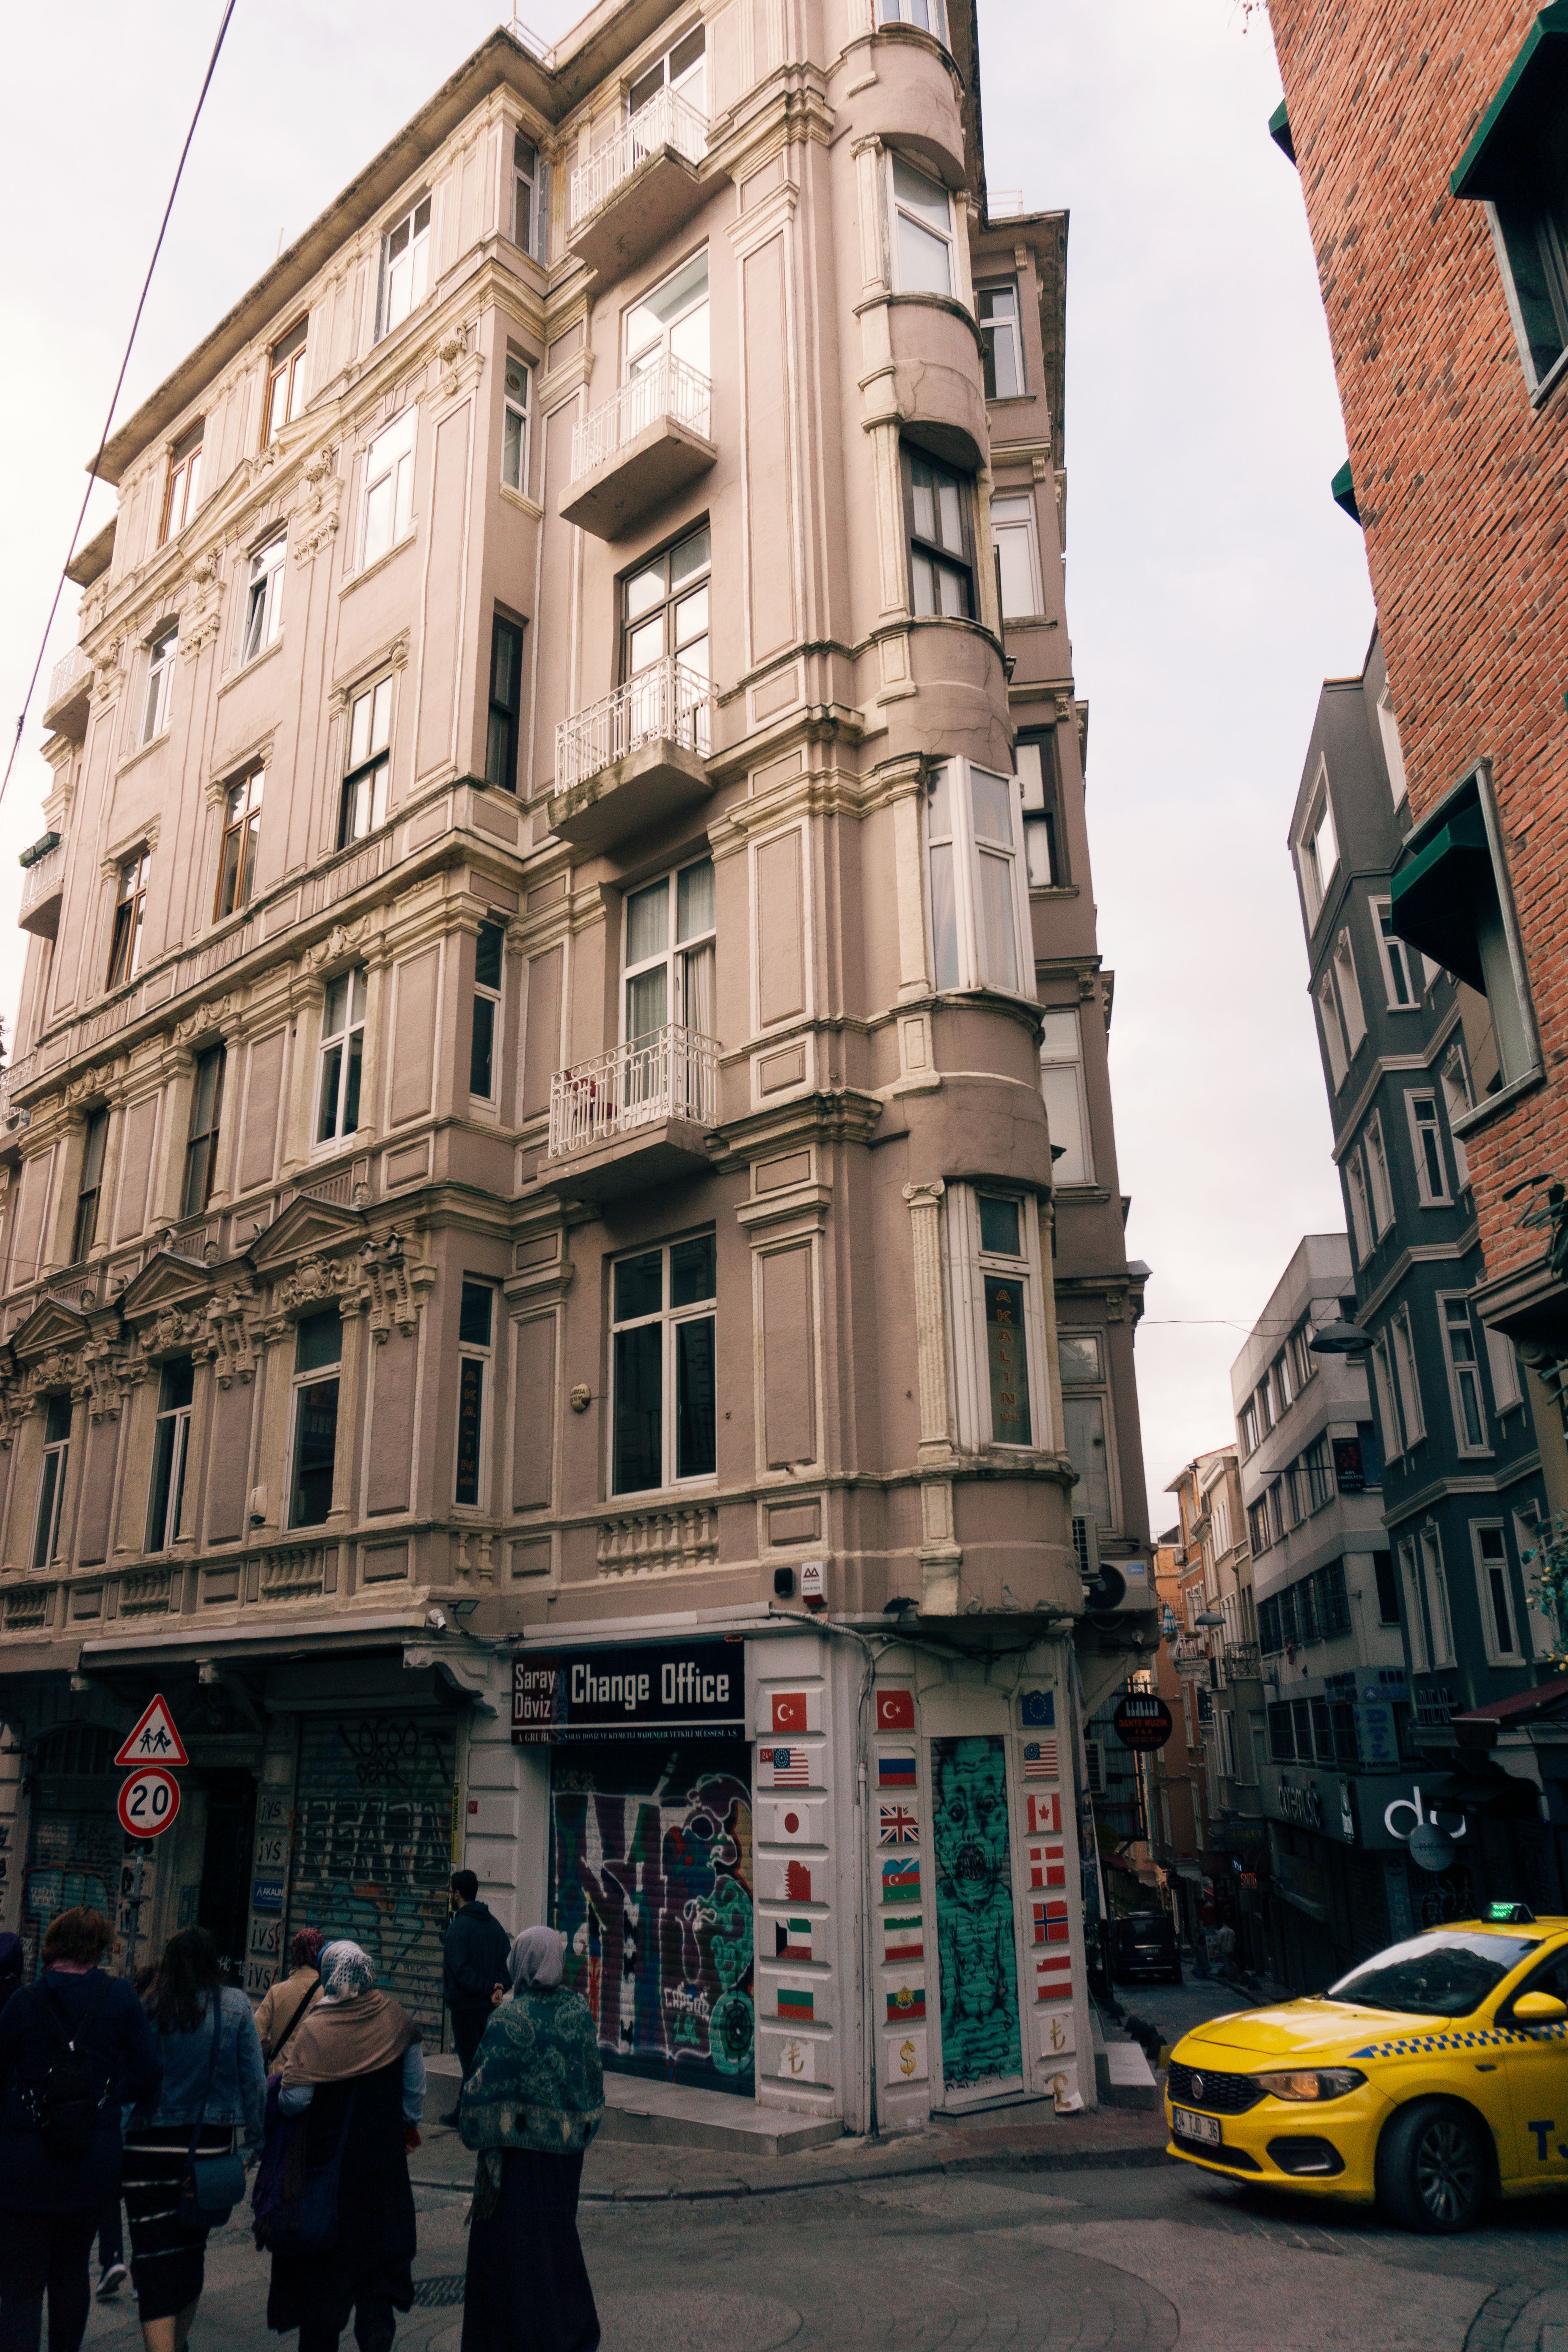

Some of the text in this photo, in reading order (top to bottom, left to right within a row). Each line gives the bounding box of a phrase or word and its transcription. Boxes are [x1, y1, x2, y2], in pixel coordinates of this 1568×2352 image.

[996, 1290, 1017, 1405] AKALIN
[460, 1371, 477, 1472] AKALIN
[515, 1664, 556, 1694] Saray
[572, 1662, 729, 1710] Change Office
[515, 1692, 550, 1719] Döviz
[583, 1730, 599, 1740] DÖVİZ
[1119, 1719, 1142, 1727] DANTE
[518, 1733, 523, 1742] A
[131, 1785, 168, 1816] 20
[1208, 2120, 1217, 2139] 36
